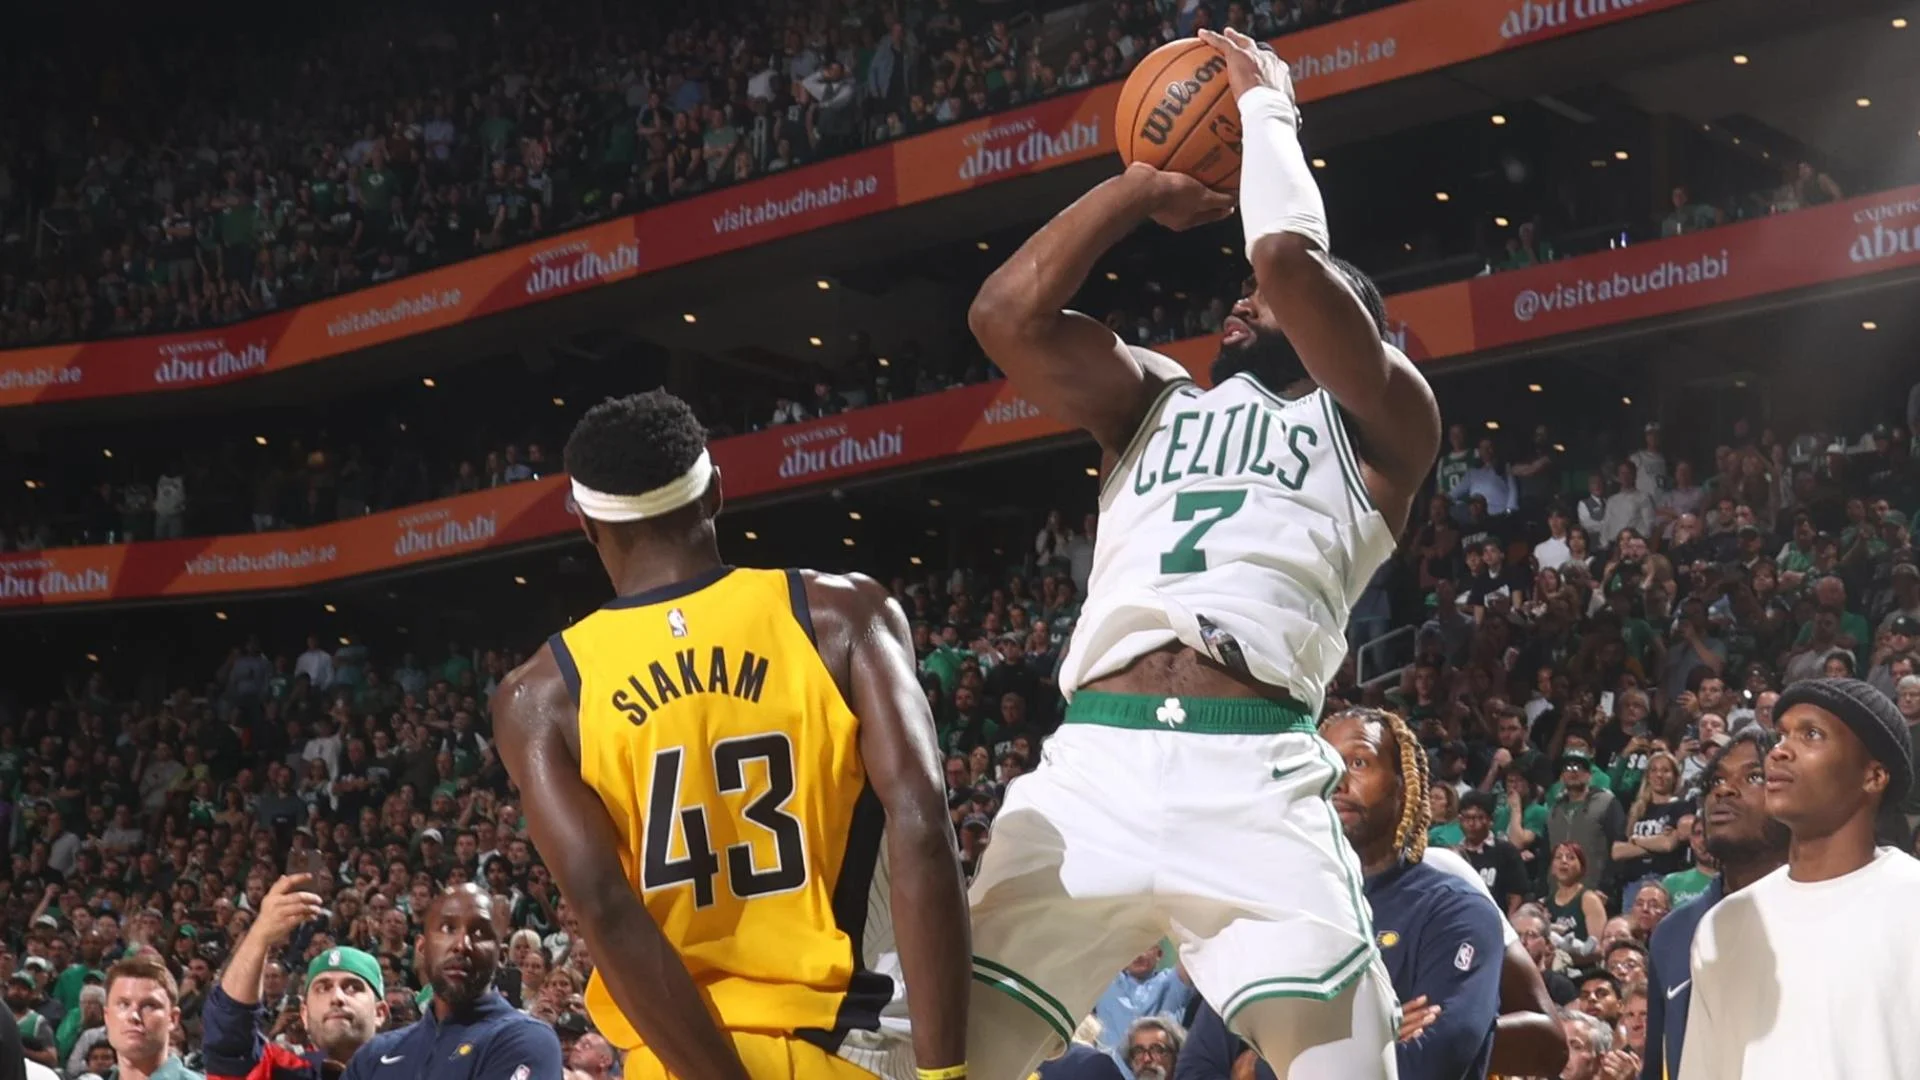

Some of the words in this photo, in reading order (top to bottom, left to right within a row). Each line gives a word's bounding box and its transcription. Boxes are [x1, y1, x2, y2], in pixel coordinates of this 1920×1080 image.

[1140, 55, 1228, 145] Wilson
[959, 145, 1012, 179] abu
[1017, 114, 1100, 165] dhabi
[712, 174, 878, 235] visitabudhabi.ae
[526, 266, 569, 296] abu
[573, 238, 639, 283] dhabi
[1848, 225, 1920, 263] abu
[327, 288, 462, 337] visitabudhabi.ae
[1513, 250, 1729, 321] @visitabudhabi
[154, 356, 204, 384] abu
[207, 338, 268, 379] dhabi
[779, 449, 826, 478] abu
[830, 424, 903, 468] dhabi
[1134, 402, 1318, 496] CELTICS
[185, 544, 337, 576] visitabudhabi.ae
[394, 529, 433, 557] abu
[436, 510, 497, 549] dhabi
[1160, 489, 1249, 575] 7
[0, 575, 35, 599] bu
[38, 565, 109, 595] dhabi
[611, 646, 770, 727] SIAKAM
[640, 730, 810, 912] 43
